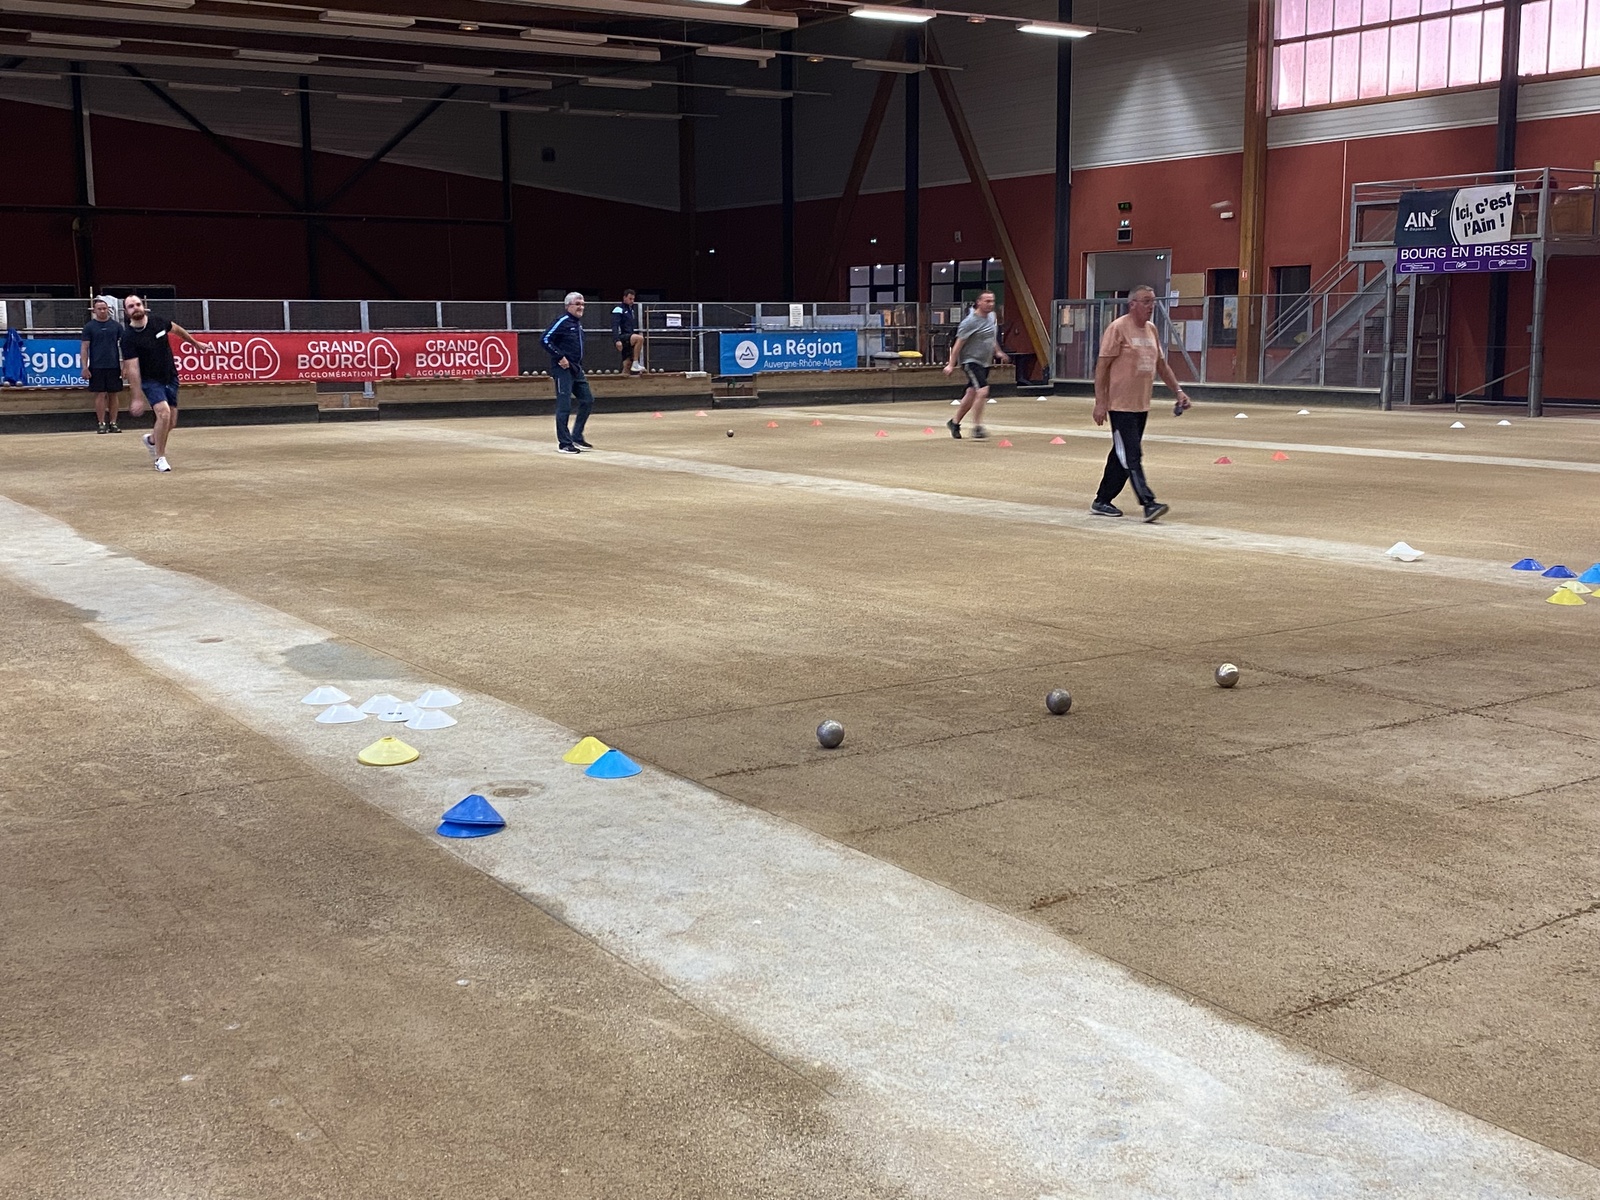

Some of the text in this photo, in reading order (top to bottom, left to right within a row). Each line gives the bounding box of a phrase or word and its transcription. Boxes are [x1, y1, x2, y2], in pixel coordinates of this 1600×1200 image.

[1455, 192, 1512, 221] Ici, c'est
[1404, 212, 1434, 228] AIN
[1463, 218, 1496, 237] l'Ain
[1401, 244, 1528, 259] BOURG EN BRESSE
[307, 340, 365, 353] GRAND
[425, 339, 478, 352] GRAND
[763, 338, 842, 358] La Région
[297, 354, 367, 369] BOURG
[415, 352, 480, 367] BOURG
[763, 358, 842, 370] Auvergne-Rhône-Alpes
[27, 373, 89, 386] hône-Alpes
[178, 372, 251, 381] GGLOMÉRATION
[298, 370, 373, 378] AGGLOMÉRATION
